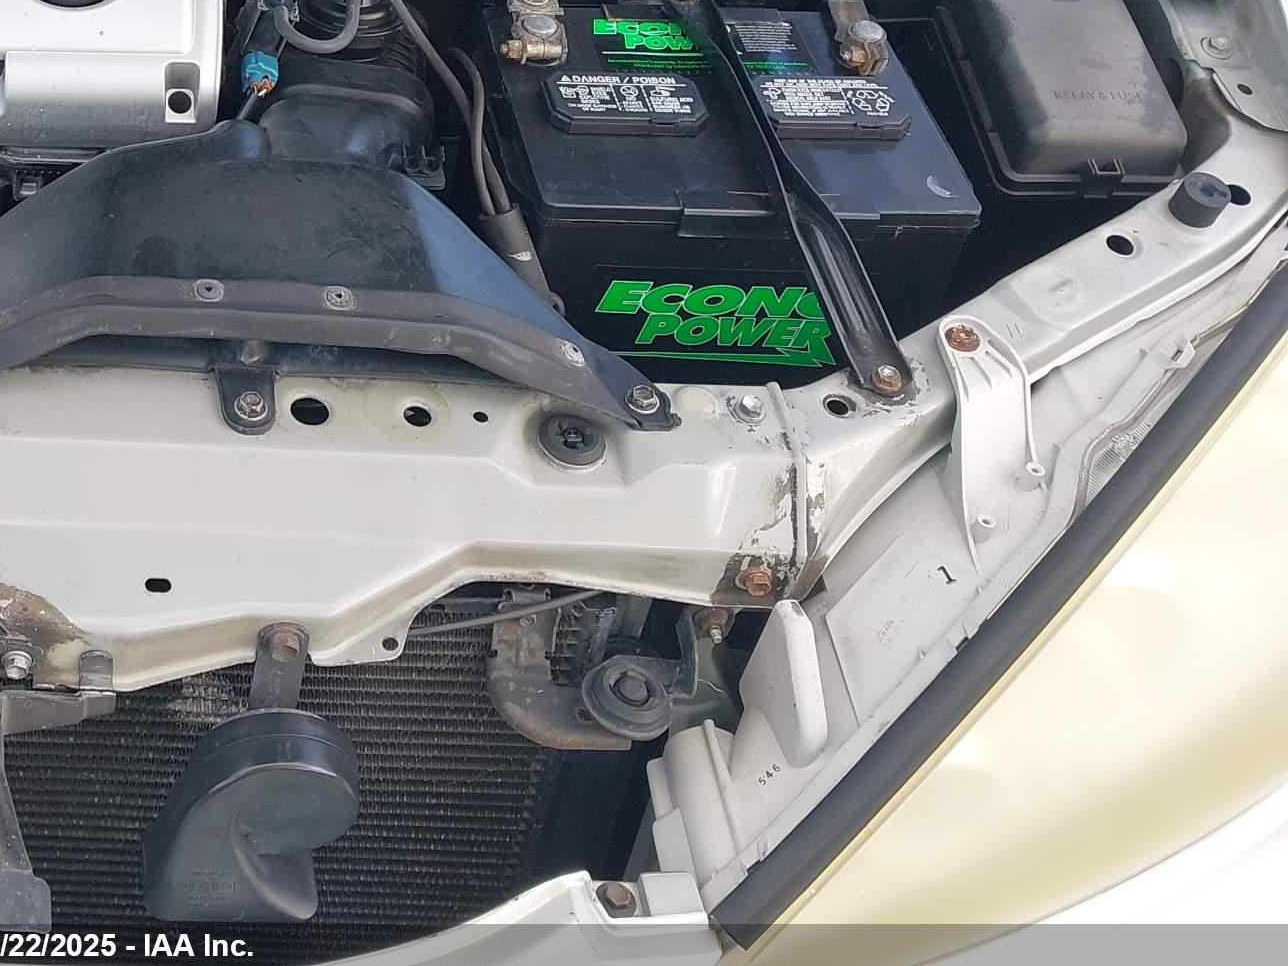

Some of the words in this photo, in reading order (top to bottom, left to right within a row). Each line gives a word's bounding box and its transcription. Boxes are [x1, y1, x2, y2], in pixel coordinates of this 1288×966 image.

[572, 75, 621, 84] DANGER
[623, 76, 630, 84] /
[632, 76, 676, 84] POISON
[634, 313, 837, 366] POWER
[936, 565, 958, 585] 1
[758, 763, 781, 786] 546
